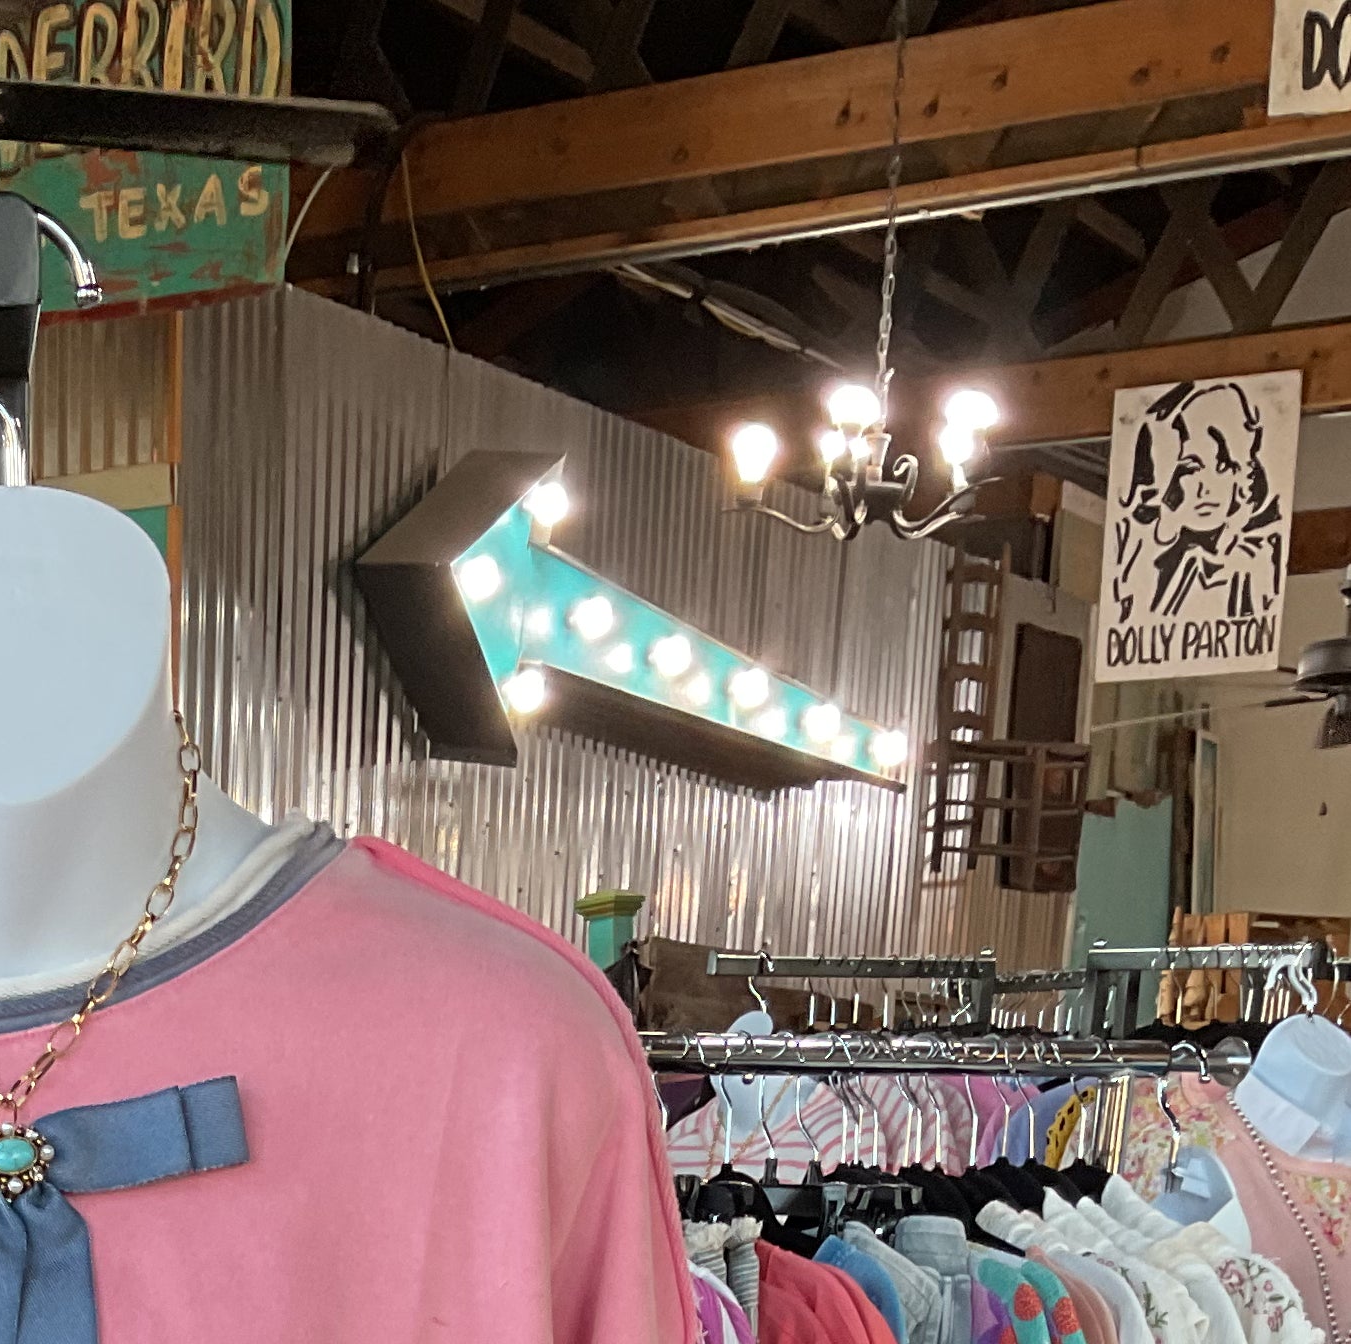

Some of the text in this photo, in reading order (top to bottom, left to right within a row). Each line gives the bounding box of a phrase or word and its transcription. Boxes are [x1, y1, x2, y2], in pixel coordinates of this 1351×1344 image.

[79, 165, 269, 241] TEXAS
[1107, 614, 1277, 667] DOLLY PARTON
